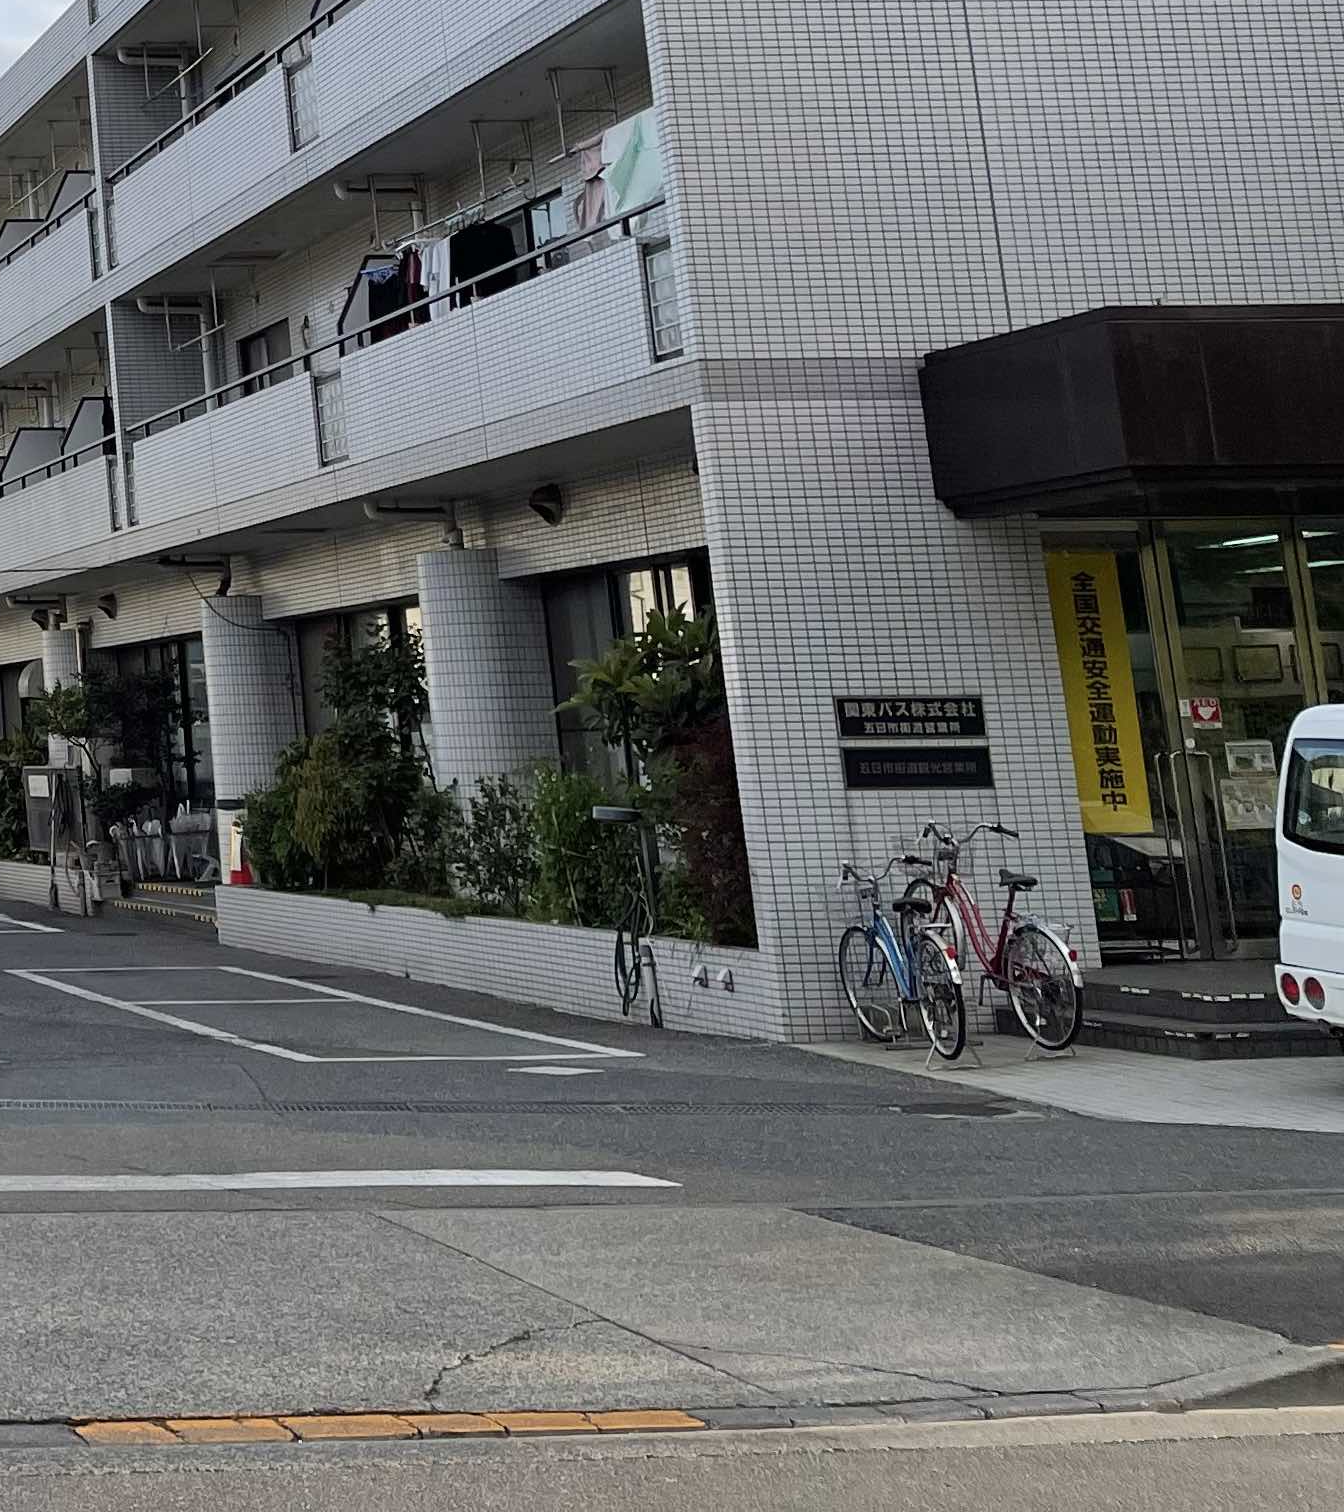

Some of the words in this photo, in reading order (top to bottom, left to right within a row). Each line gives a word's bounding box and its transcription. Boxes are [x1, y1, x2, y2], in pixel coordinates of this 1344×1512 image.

[1070, 571, 1129, 813] 全国交通安全運動実施中
[844, 701, 977, 718] 関東バス株式会社
[864, 721, 961, 734] 五日市街道営業所
